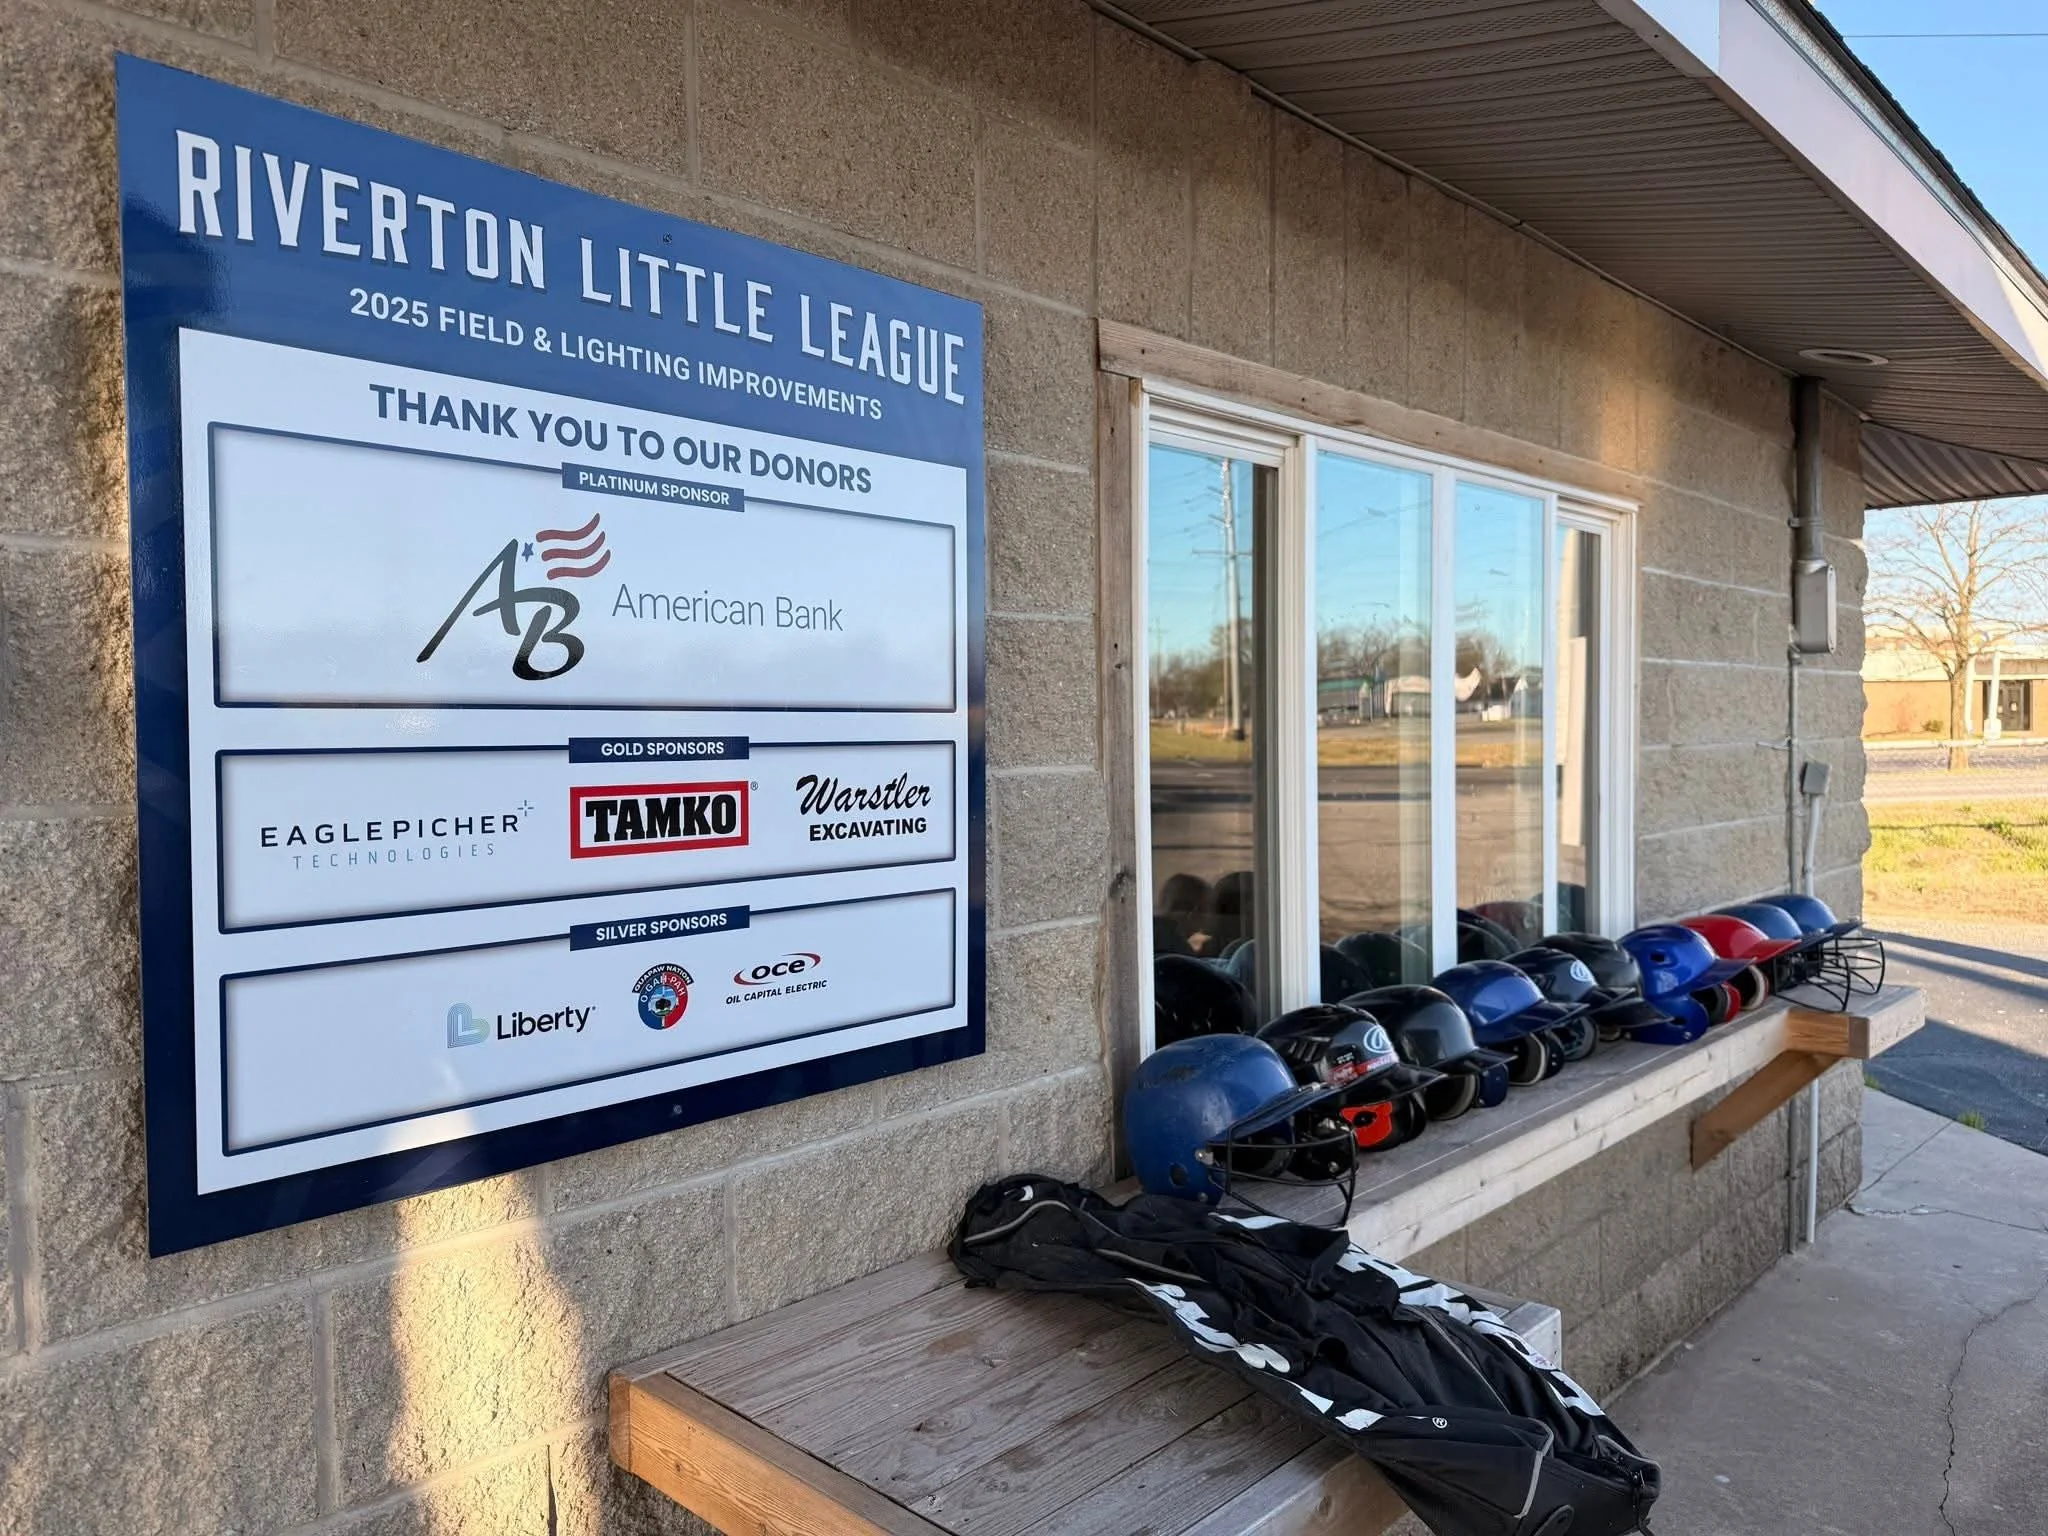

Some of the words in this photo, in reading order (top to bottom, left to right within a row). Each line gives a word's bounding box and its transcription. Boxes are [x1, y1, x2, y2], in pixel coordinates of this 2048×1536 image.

[175, 129, 546, 291] RIVERTON
[581, 237, 774, 343] LITTLE
[799, 294, 965, 405] LEAGUE
[350, 288, 429, 328] 2025
[439, 306, 524, 346] FIELD
[533, 326, 552, 353] &
[561, 331, 690, 380] LIGHTING
[699, 361, 882, 420] IMPROVEMENTS
[369, 383, 519, 439] THANK
[527, 410, 608, 451] YOU
[616, 425, 665, 460] TO
[674, 436, 742, 474] OUR
[750, 448, 872, 493] DONORS
[579, 471, 658, 495] PLATINUM
[661, 483, 730, 505] SPONSOR
[612, 583, 764, 627] American
[776, 595, 844, 632] Bank
[601, 742, 644, 756] GOLD
[647, 741, 724, 756] SPONSORS
[796, 771, 932, 816] Warstler
[260, 814, 519, 847] EAGLEPICHER
[585, 794, 737, 843] TAMKO
[809, 816, 927, 842] EXCAVATING
[293, 843, 495, 870] TECHNOLOGIES
[596, 923, 646, 941] SILVER
[650, 913, 727, 936] SPONSORS
[634, 964, 665, 992] QUAPAW
[666, 964, 693, 984] NATION
[751, 959, 806, 980] oce
[725, 995, 741, 1005] OIL
[744, 988, 783, 1002] CAPITAL
[785, 980, 828, 995] ELECTRIC
[497, 1006, 591, 1041] Liberty
